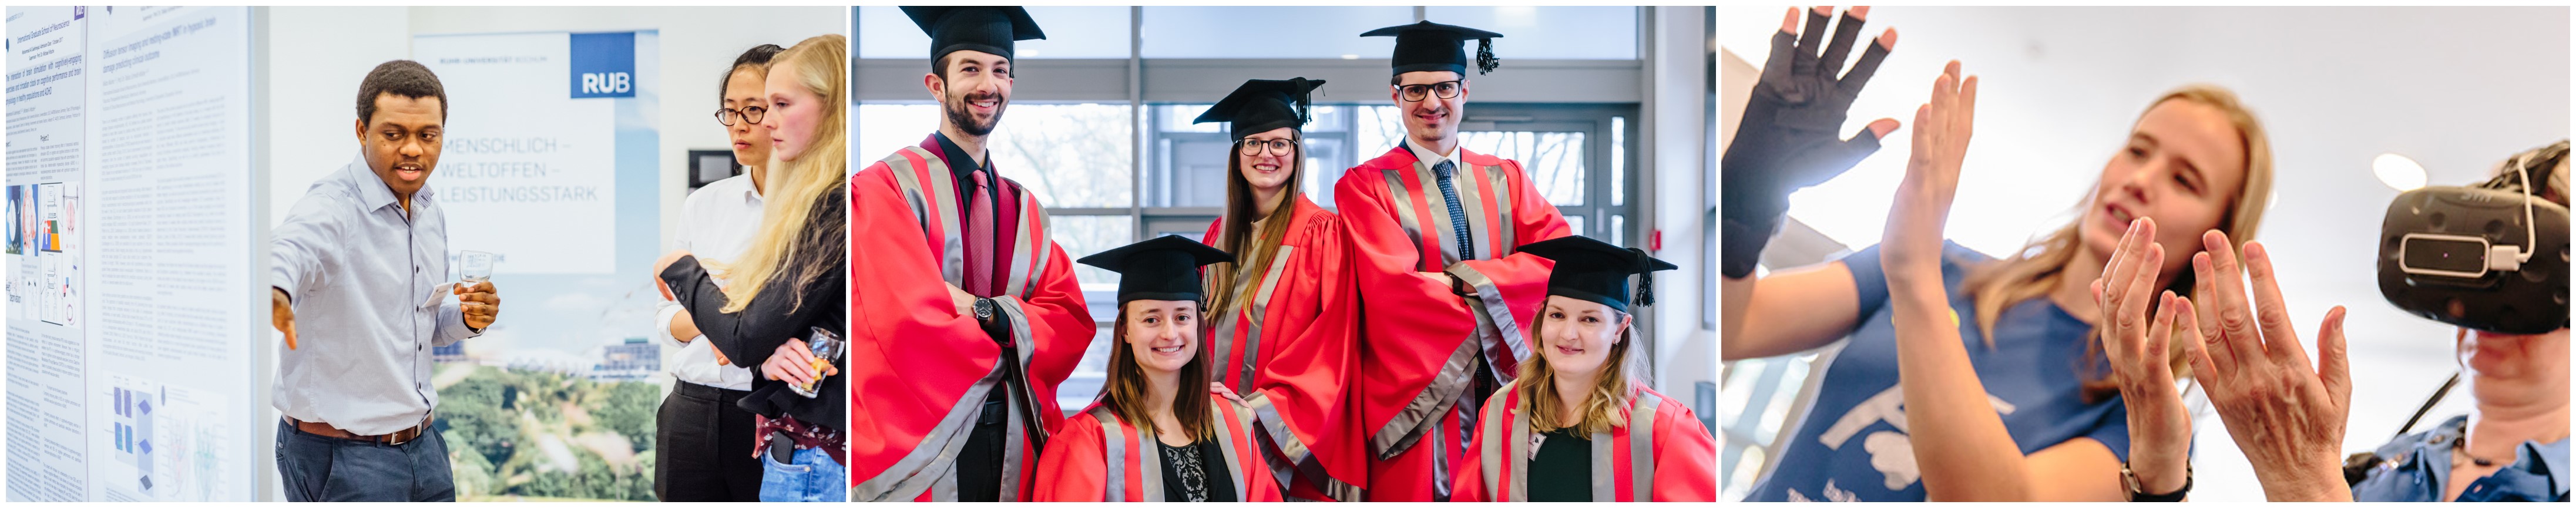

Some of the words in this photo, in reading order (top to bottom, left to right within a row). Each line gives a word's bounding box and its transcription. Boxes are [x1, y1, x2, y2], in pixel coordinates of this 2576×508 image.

[582, 72, 630, 93] RUB
[444, 137, 557, 154] MENSCHLICH
[441, 162, 546, 179] WELTOFFEN
[441, 186, 599, 203] LEISTUNGSSTARK
